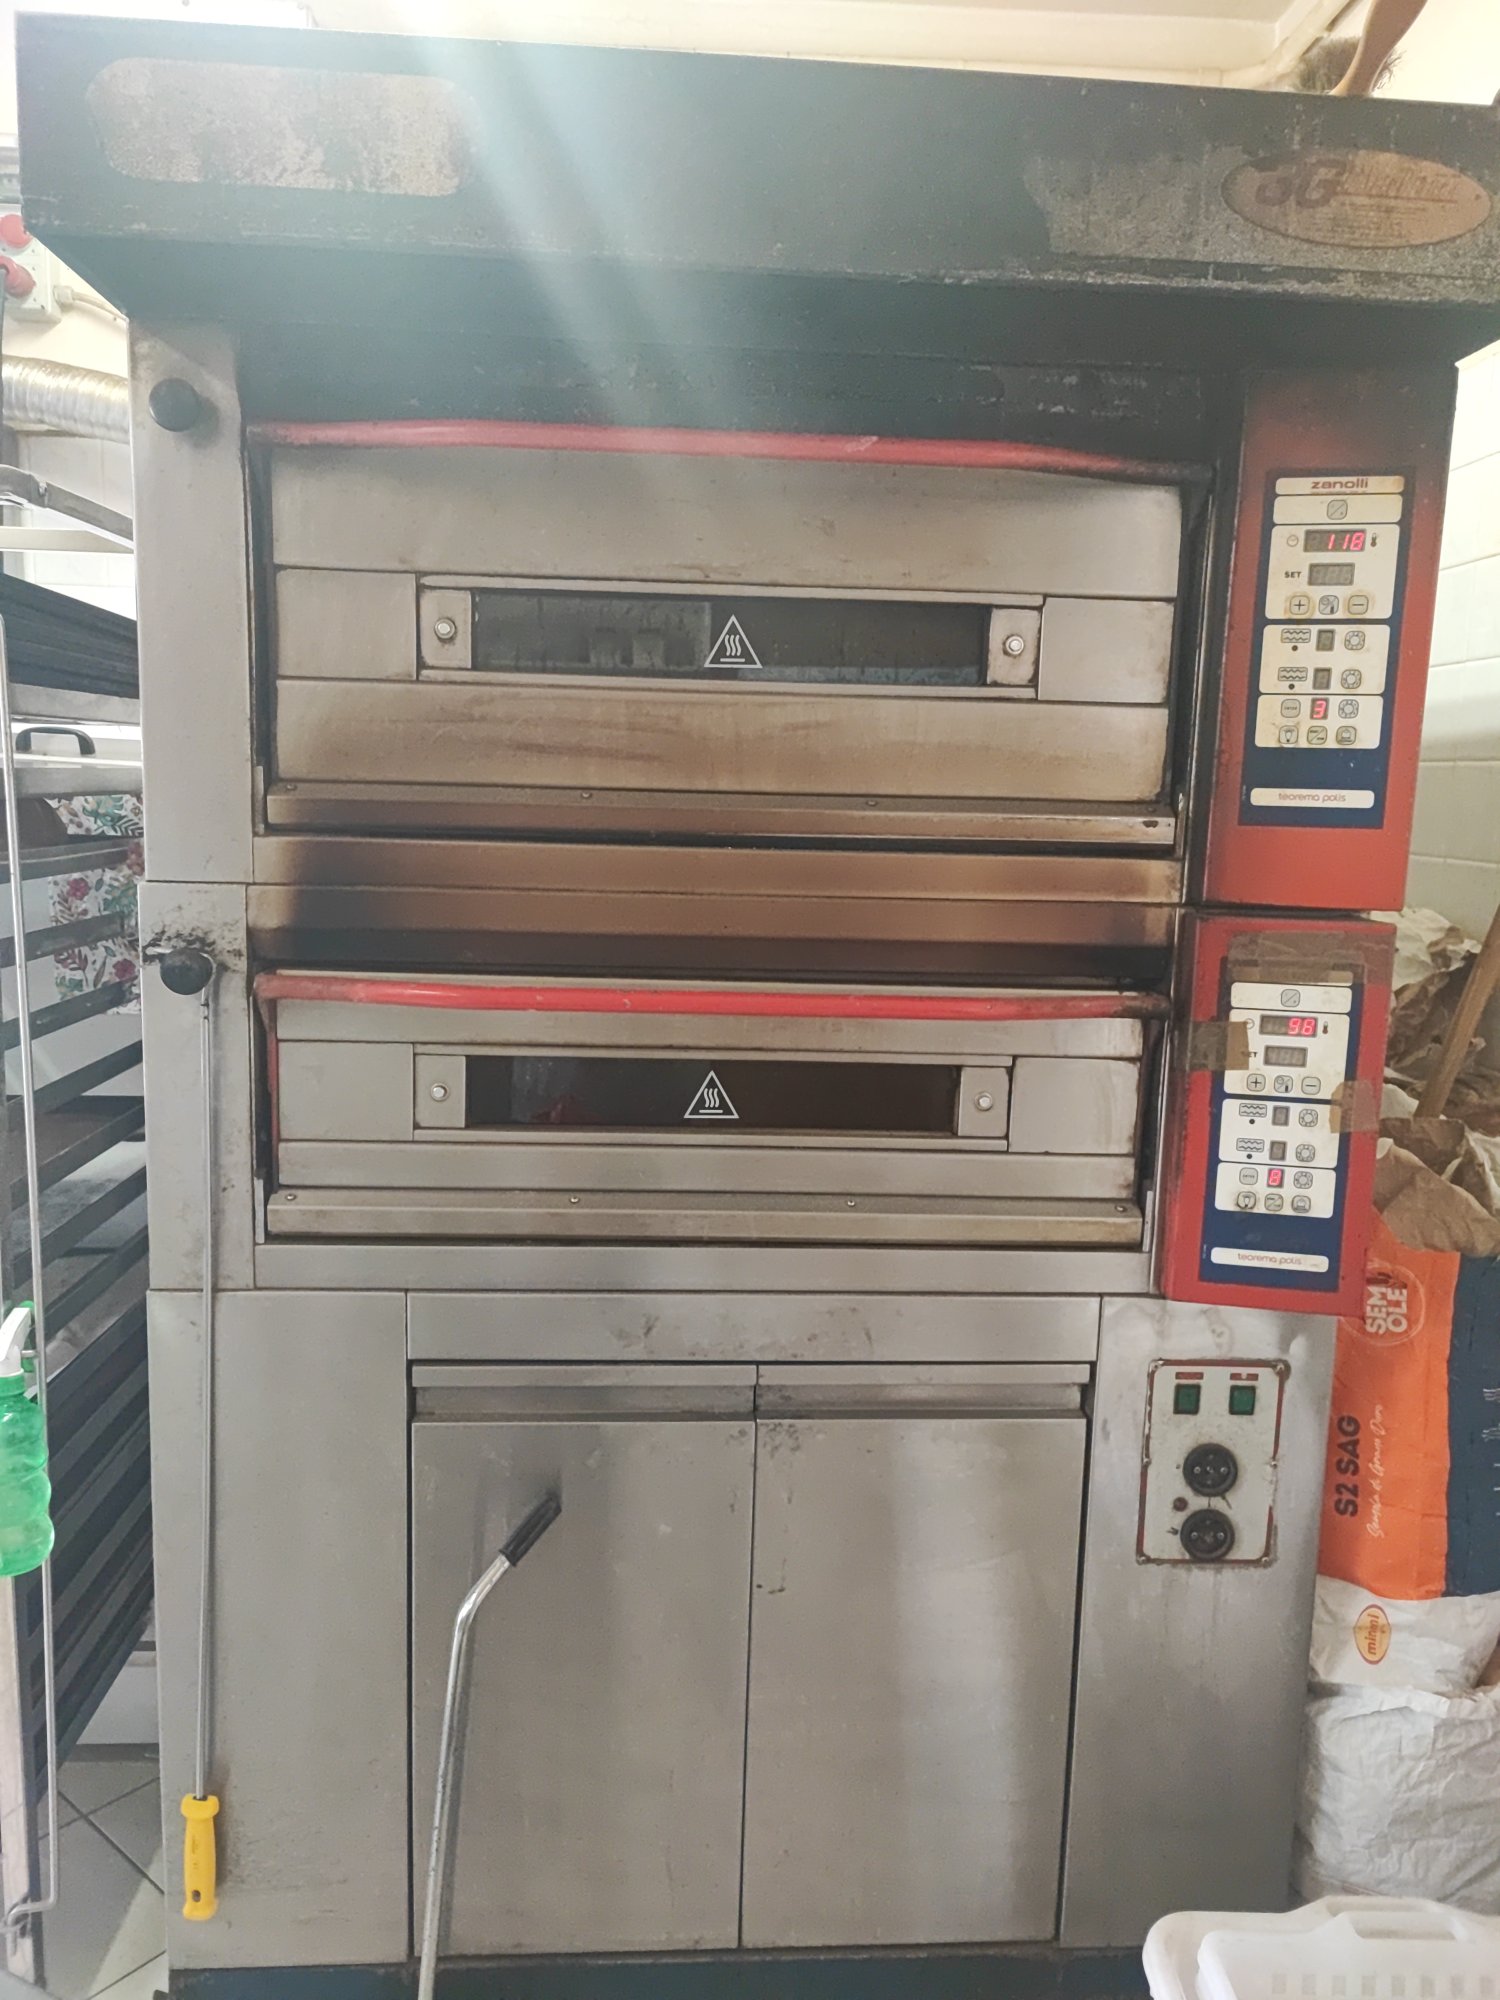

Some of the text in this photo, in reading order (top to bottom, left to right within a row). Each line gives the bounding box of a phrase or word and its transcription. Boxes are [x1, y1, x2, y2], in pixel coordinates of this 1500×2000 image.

[1311, 478, 1369, 489] zanolli
[1327, 532, 1365, 551] 118
[1313, 701, 1327, 719] 3
[1278, 792, 1346, 803] teorema polis
[1238, 1253, 1302, 1266] teorema polis
[1365, 1286, 1387, 1335] SEM
[1386, 1288, 1408, 1333] OLE
[1334, 1415, 1361, 1517] S2 SAG
